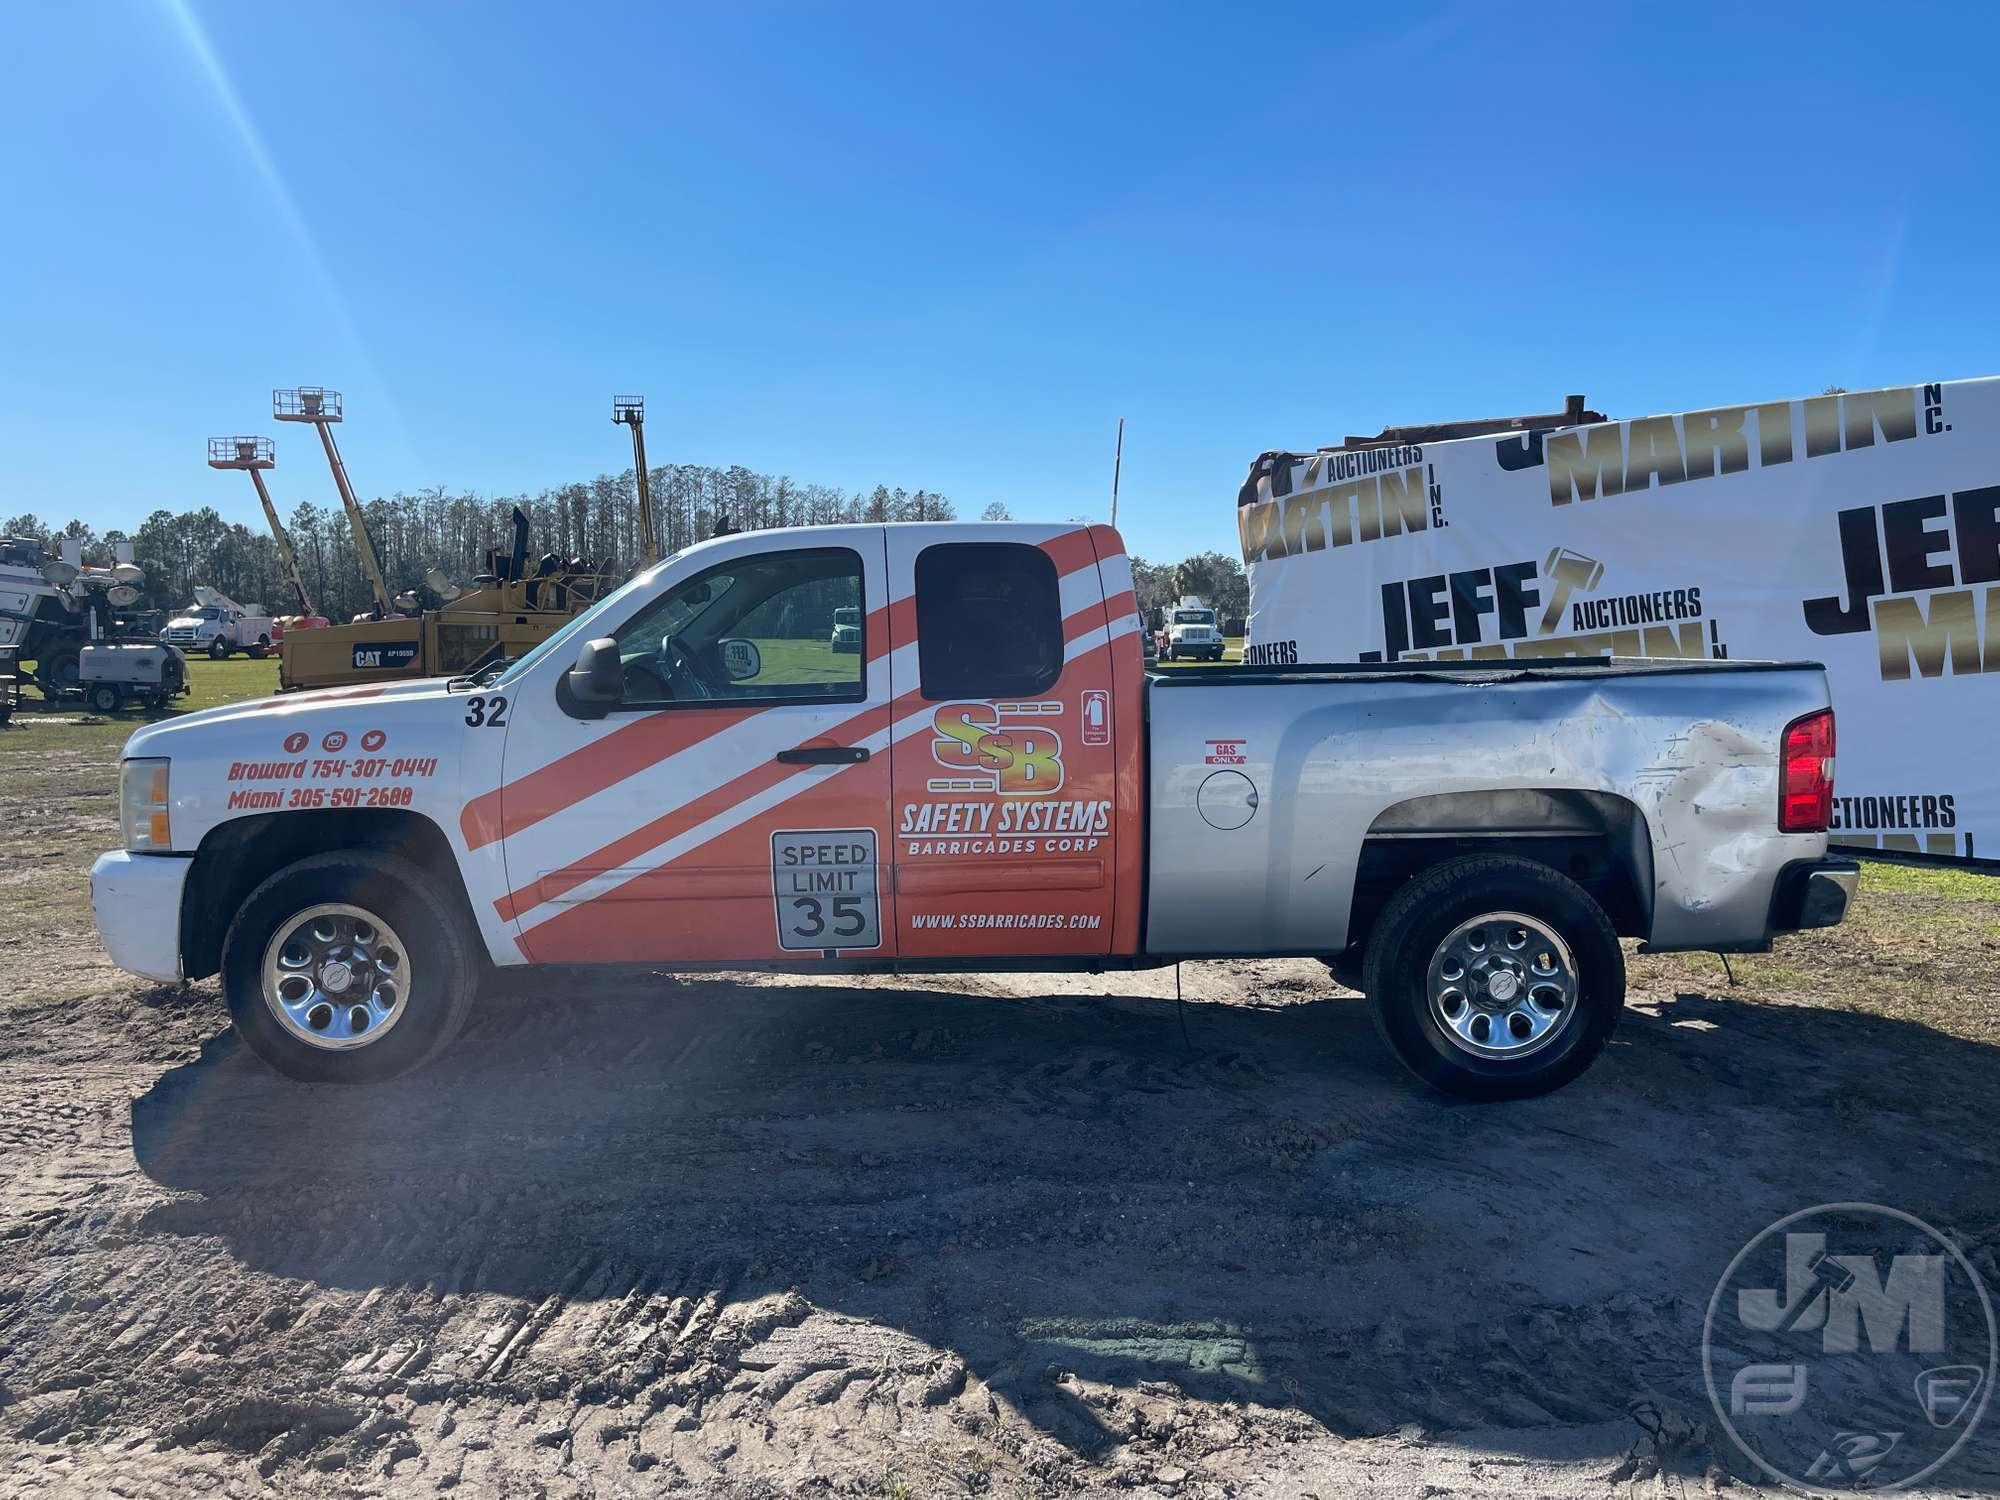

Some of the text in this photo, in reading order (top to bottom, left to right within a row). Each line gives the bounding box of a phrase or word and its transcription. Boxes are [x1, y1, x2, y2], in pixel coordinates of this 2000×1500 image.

[1923, 383, 1953, 435] NC.
[1327, 446, 1424, 483] AUCTIONEERS
[1238, 466, 1428, 566] ARTIN
[1428, 463, 1449, 528] INC.
[1803, 486, 2000, 636] JEF
[1359, 560, 1541, 662] JEFF
[1573, 587, 1702, 632] AUCTIONEERS
[1709, 619, 1728, 660] IN
[356, 651, 382, 667] CAT
[464, 697, 508, 727] 32
[1212, 756, 1239, 764] ONLY
[1216, 744, 1236, 755] GAS
[227, 758, 438, 781] Broward 754-307-0441
[227, 786, 413, 810] Miami 305-591-2688
[1829, 794, 1956, 829] CTIONEERS
[900, 801, 1111, 836] SAFETY SYSTEMS
[783, 844, 867, 866] SPEED
[908, 838, 1099, 856] BARRICADES CORP
[793, 871, 858, 892] LIMIT
[793, 897, 866, 938] 35
[911, 914, 1101, 929] WWW.SSBARRICADES.COM
